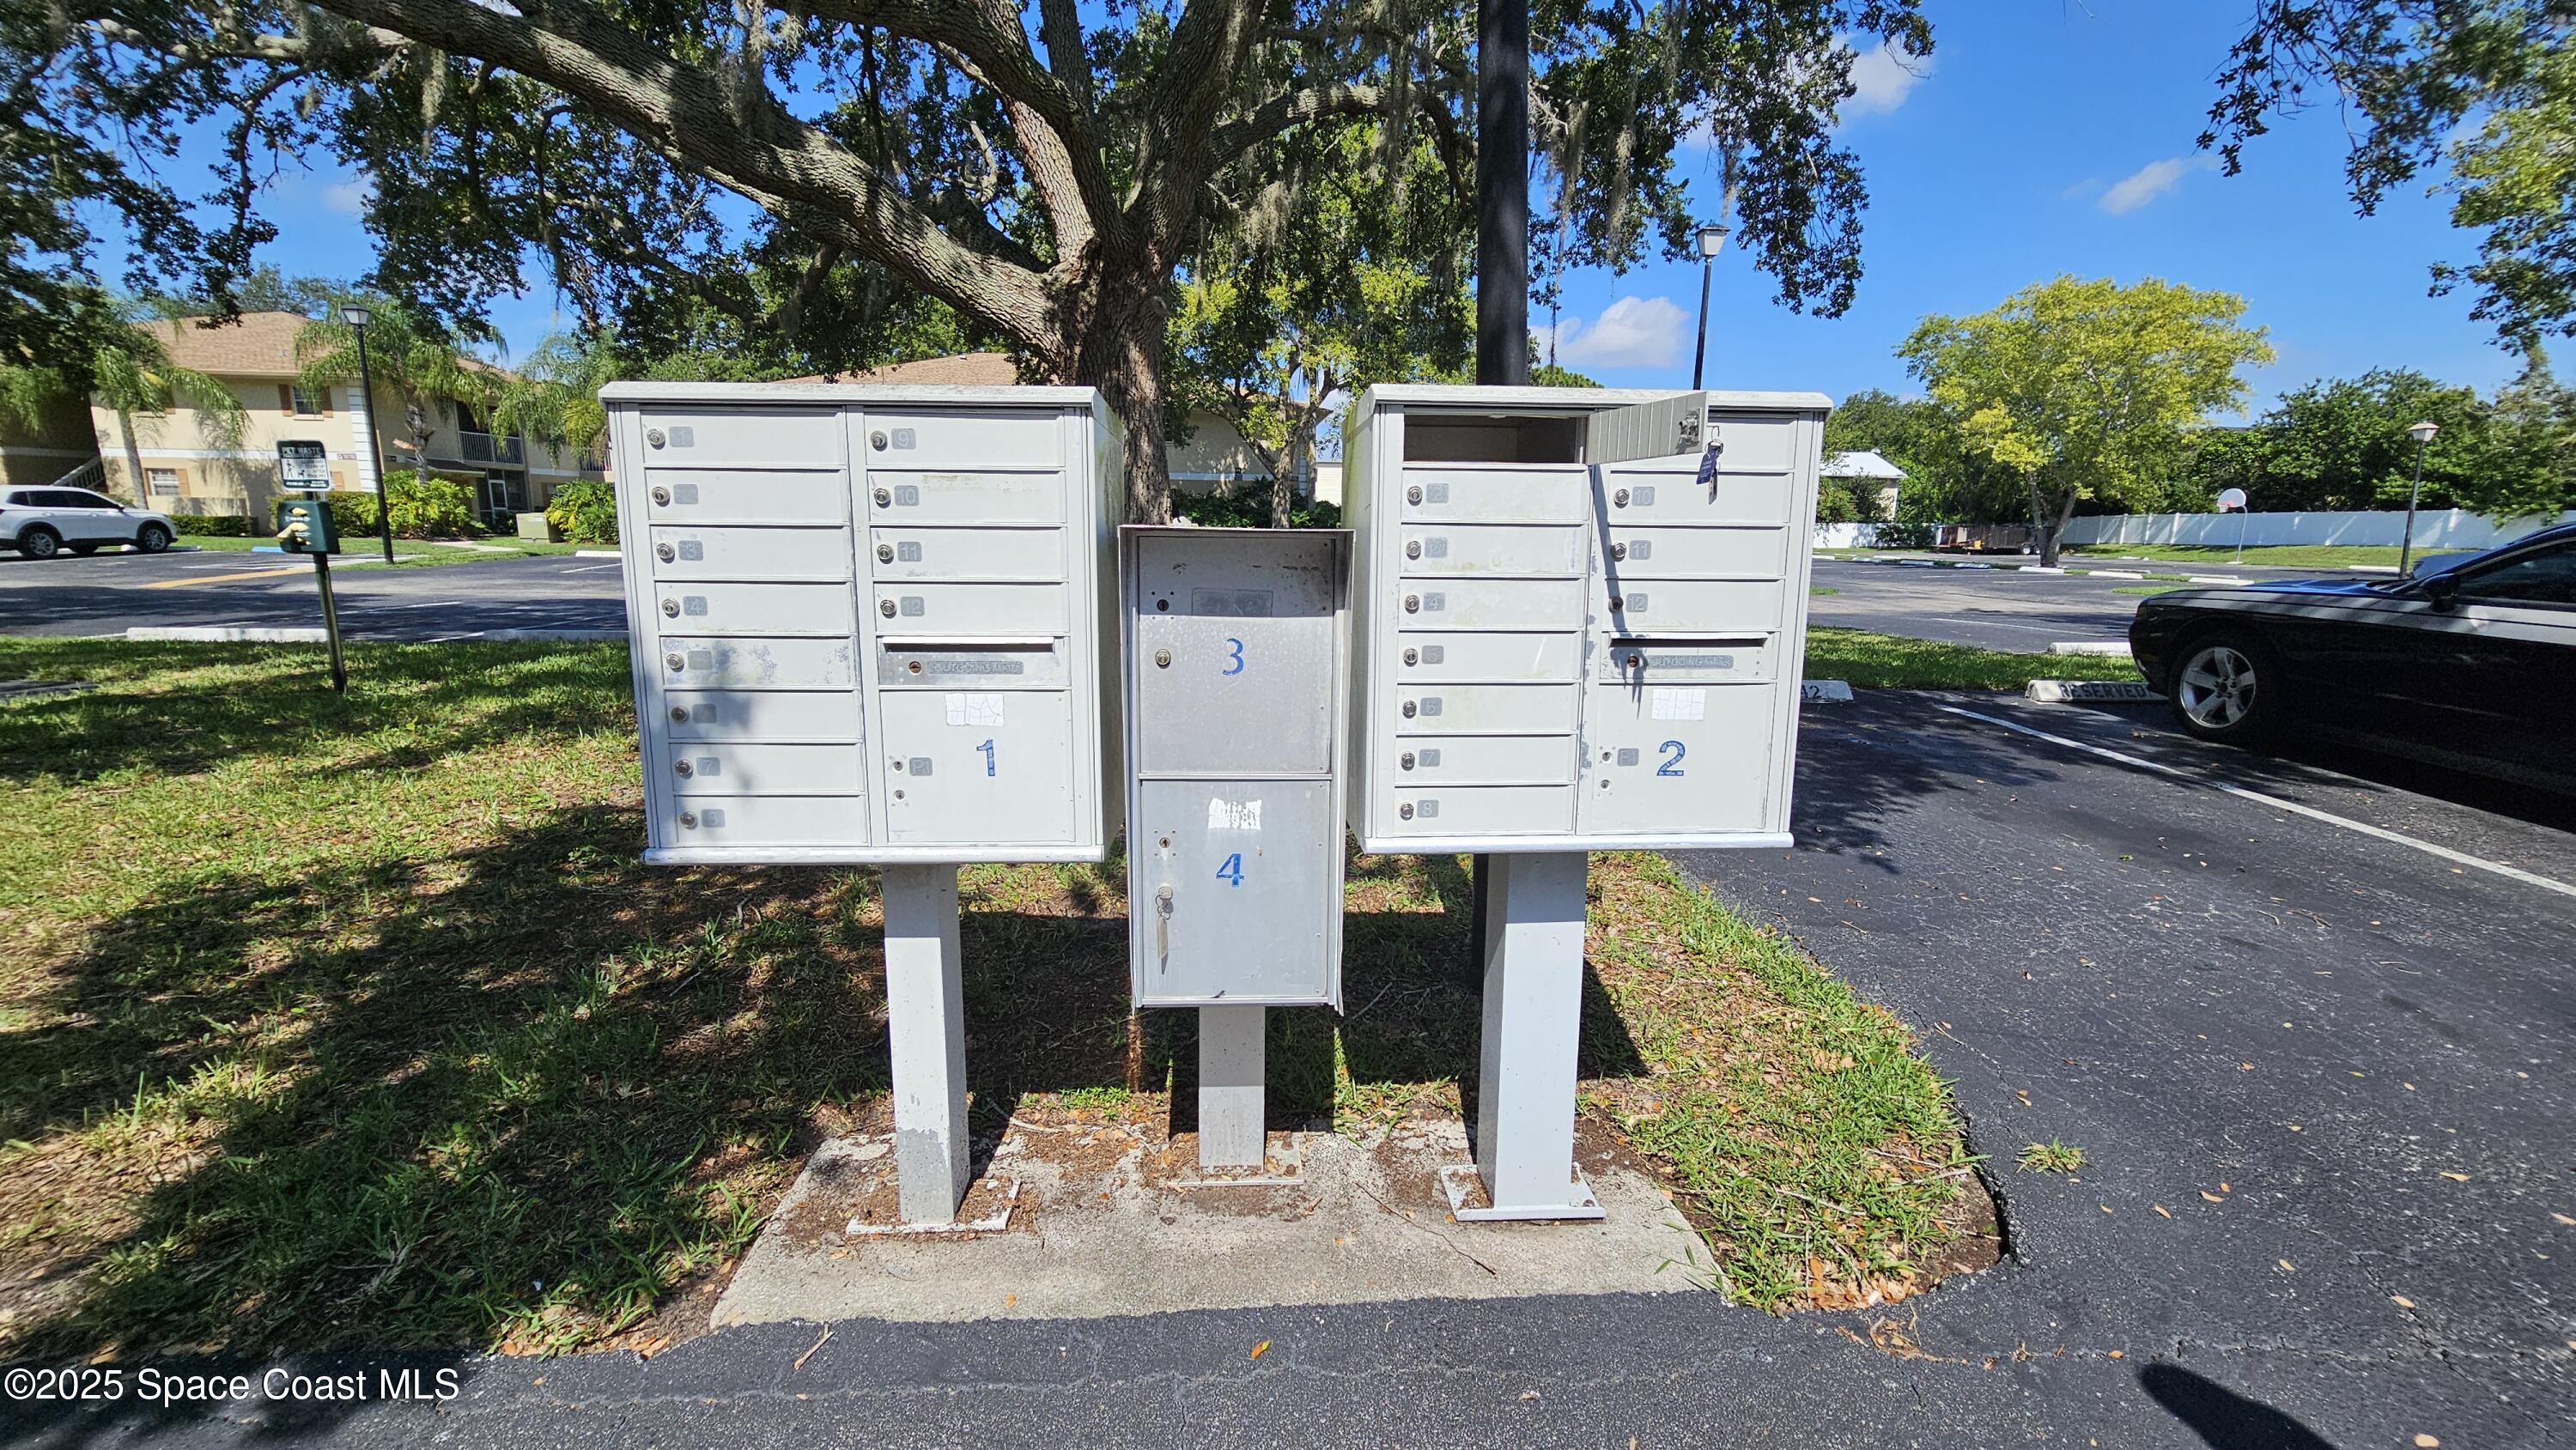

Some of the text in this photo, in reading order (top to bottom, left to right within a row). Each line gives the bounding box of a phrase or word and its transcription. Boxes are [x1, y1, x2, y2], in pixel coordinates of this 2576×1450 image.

[897, 431, 908, 447] 9
[898, 488, 916, 505] 10
[1635, 489, 1651, 505] 10
[902, 544, 919, 561] 11
[1633, 543, 1649, 558] 11
[903, 599, 922, 616] 12
[1628, 596, 1645, 611] 12
[1222, 637, 1244, 676] 3
[2059, 683, 2147, 698] RESERVED
[1426, 700, 1436, 715] 6
[976, 738, 996, 777] 1
[1425, 751, 1435, 766] 7
[1656, 740, 1686, 777] 2
[703, 760, 714, 774] 7
[1423, 802, 1433, 816] 8
[708, 810, 719, 825] 8
[1215, 852, 1245, 888] 4
